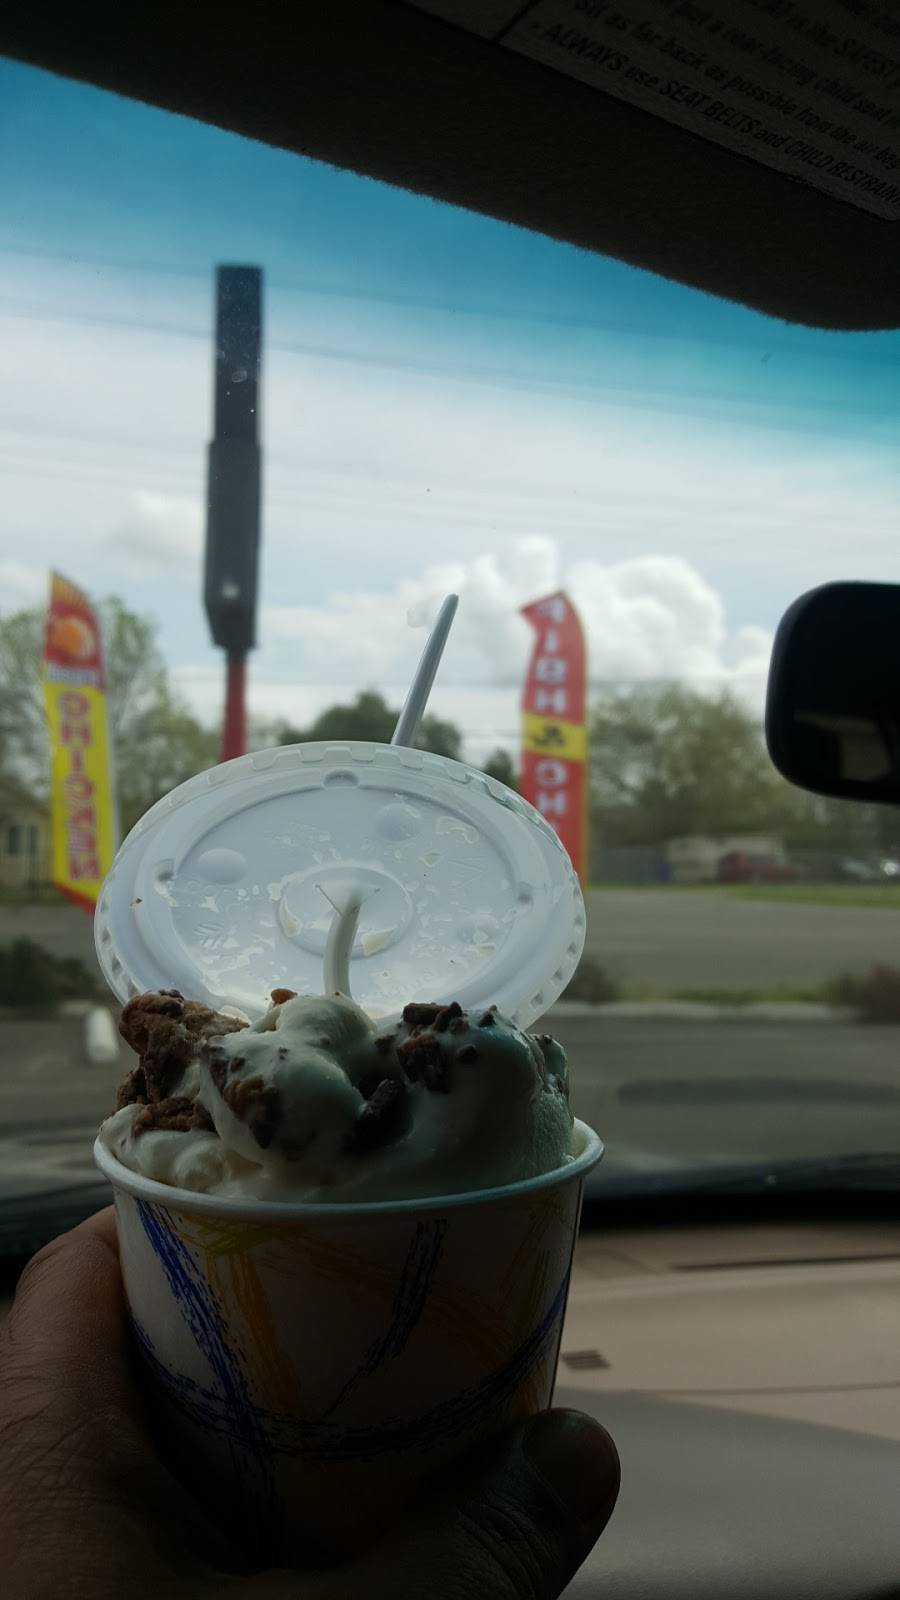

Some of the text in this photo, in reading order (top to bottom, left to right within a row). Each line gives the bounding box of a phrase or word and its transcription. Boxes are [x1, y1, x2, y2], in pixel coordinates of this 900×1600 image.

[545, 24, 629, 72] ALWAYS
[624, 65, 660, 89] use
[658, 79, 713, 112] SEAT
[702, 100, 762, 134] BELTS
[751, 125, 793, 148] and
[784, 139, 835, 169] CHILD
[657, 36, 708, 70] back
[704, 64, 730, 82] as
[720, 77, 798, 115] possible
[794, 106, 833, 134] from
[828, 125, 858, 145] the
